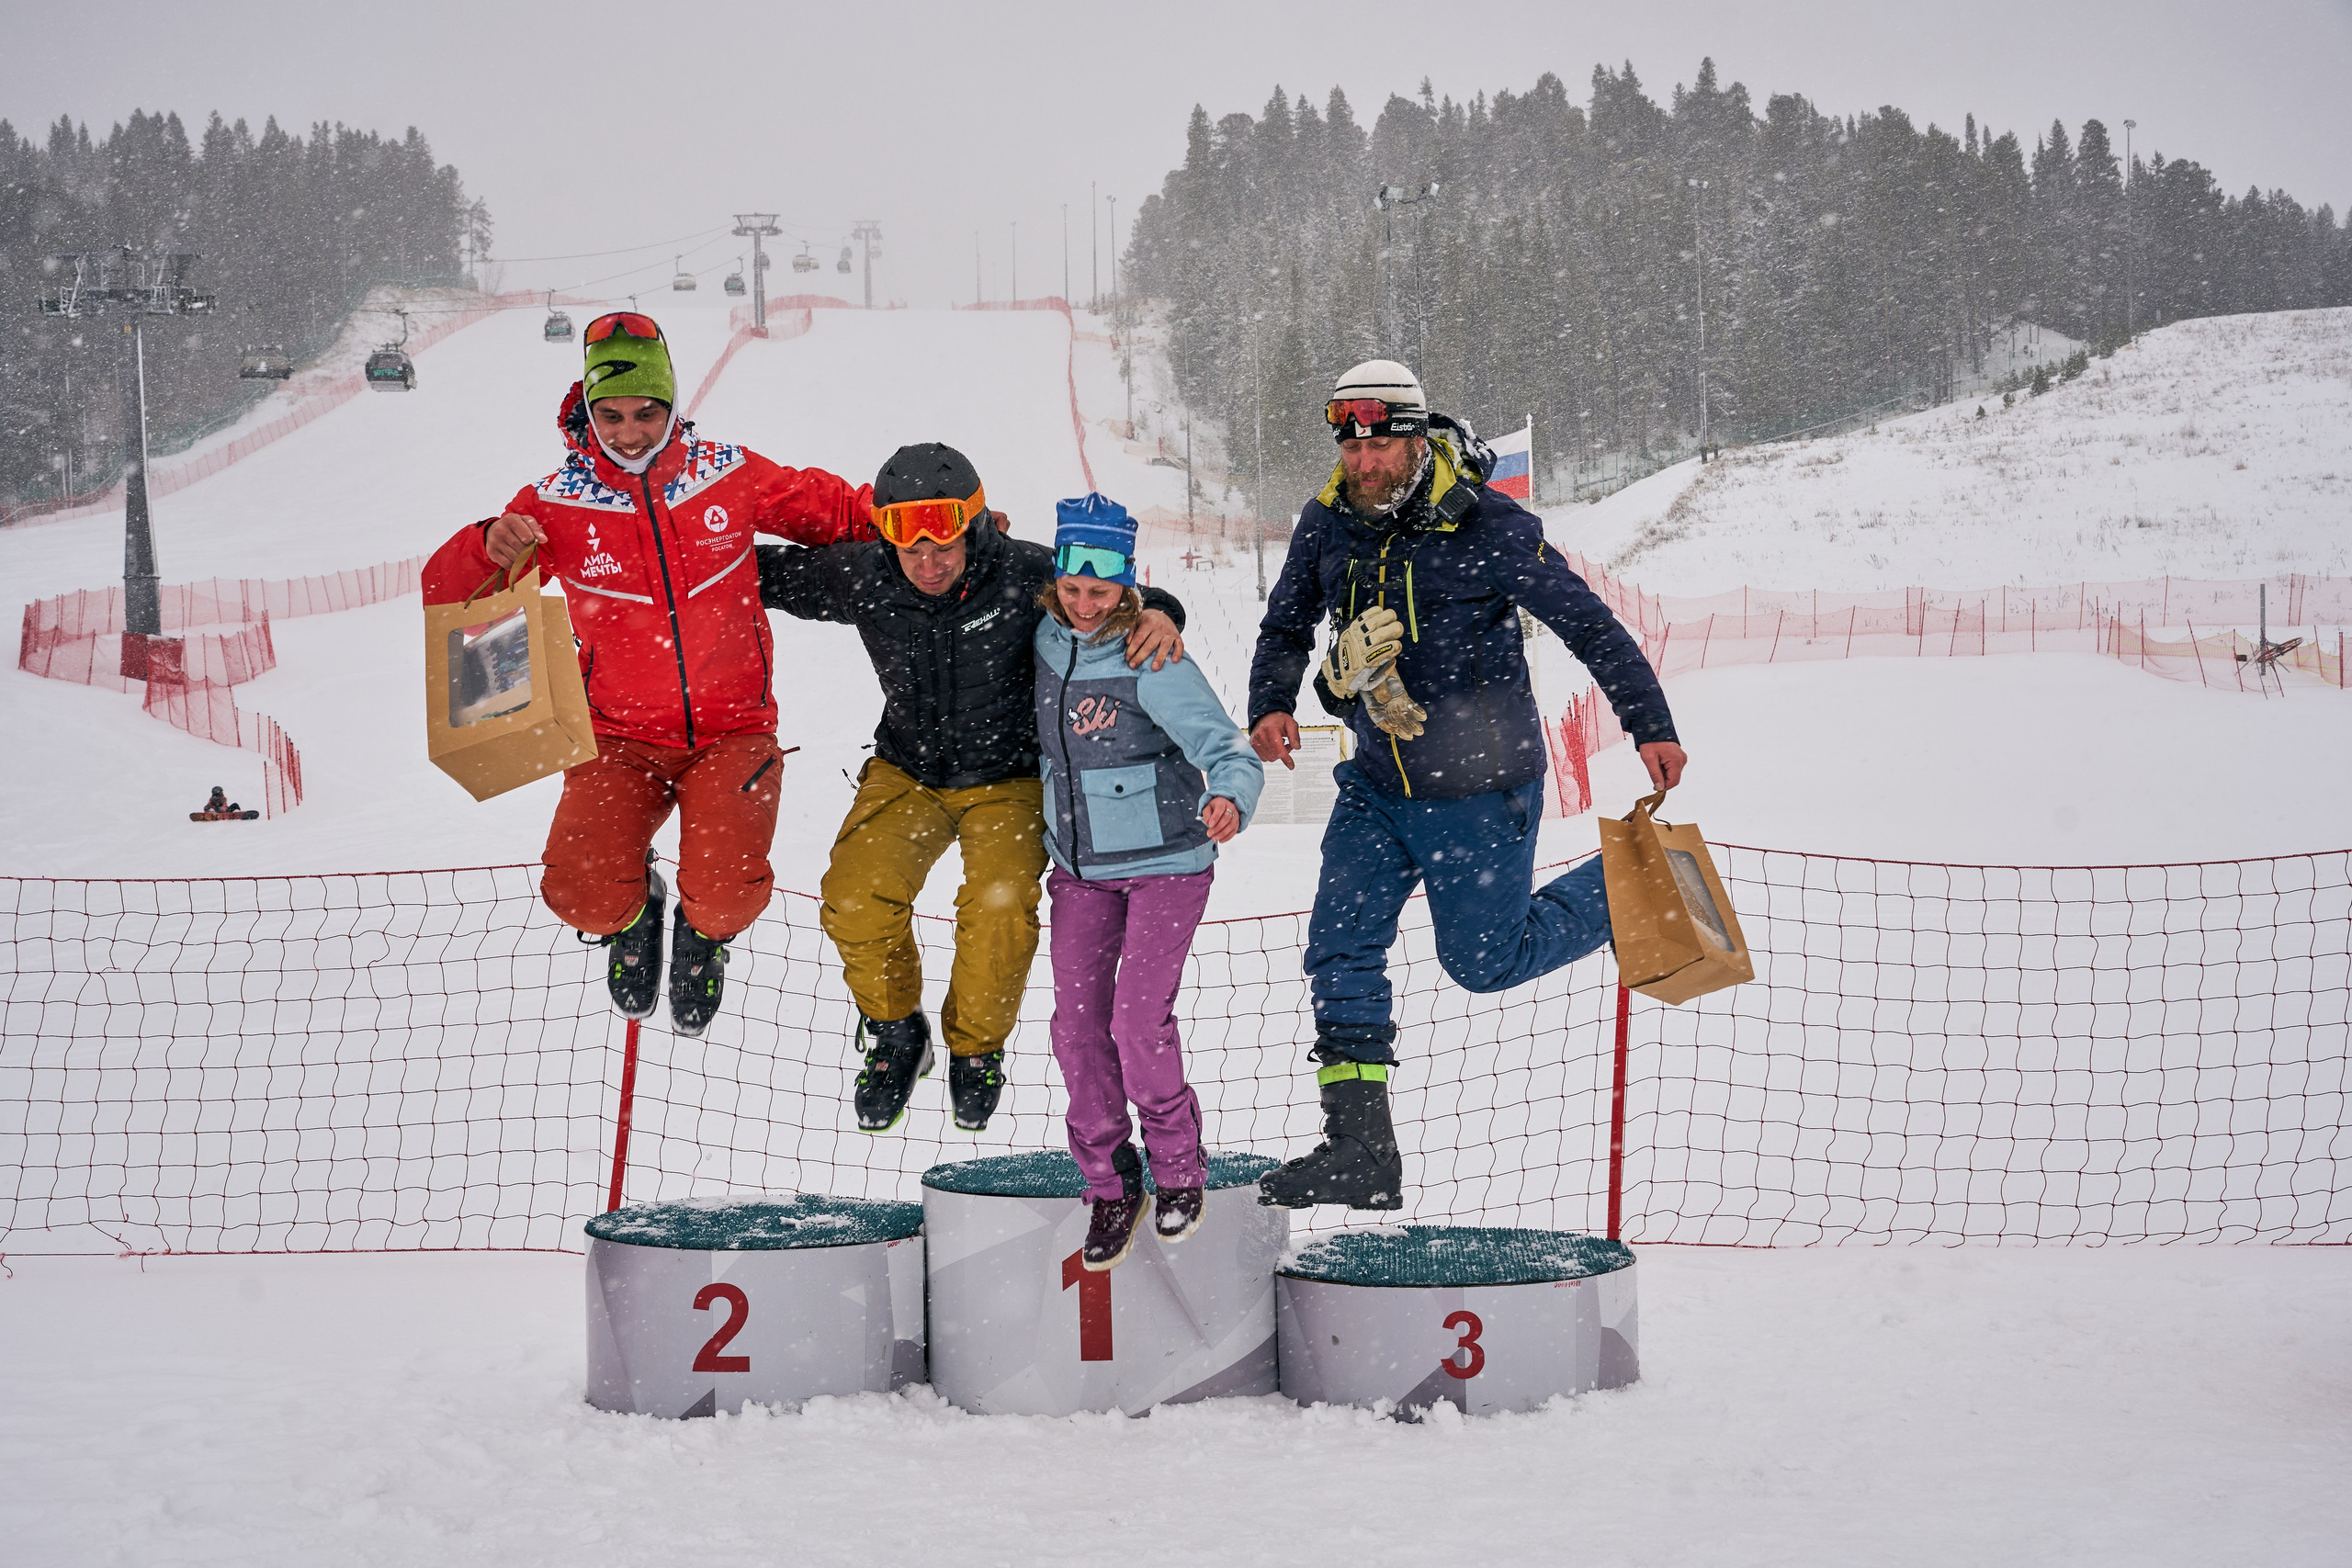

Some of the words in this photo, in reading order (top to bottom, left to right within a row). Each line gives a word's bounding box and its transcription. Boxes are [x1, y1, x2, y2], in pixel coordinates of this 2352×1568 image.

[695, 531, 742, 547] РОСЭНЕРГОАТОМ
[711, 543, 733, 552] РОСАТОМ
[580, 561, 623, 579] МЕЧТЫ
[583, 552, 616, 568] ЛИГА
[1072, 694, 1119, 736] Ski
[1062, 1247, 1113, 1361] 1
[692, 1282, 750, 1372] 2
[1441, 1310, 1486, 1380] 3
